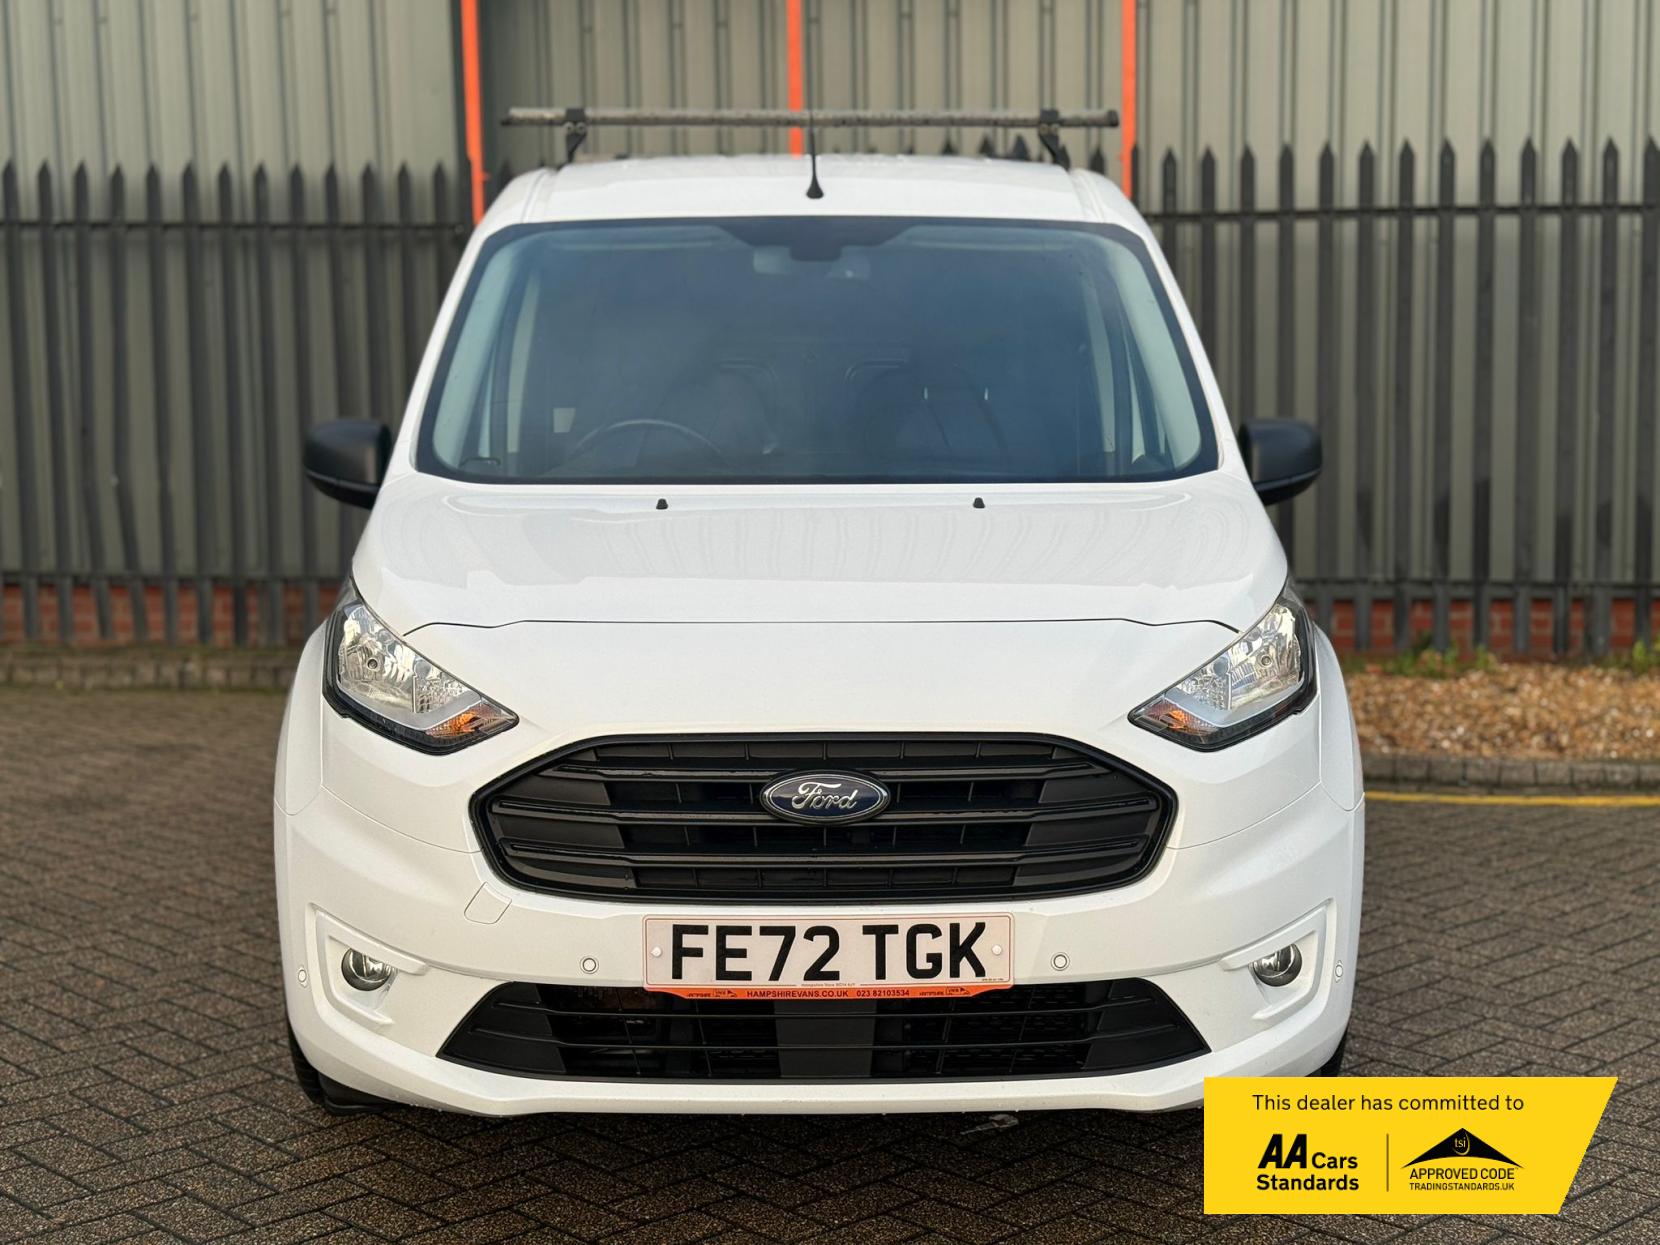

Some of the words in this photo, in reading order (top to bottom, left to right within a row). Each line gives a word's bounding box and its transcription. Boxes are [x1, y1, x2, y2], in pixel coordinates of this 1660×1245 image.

[791, 781, 858, 809] Ford
[671, 924, 840, 982] FE72
[862, 922, 986, 980] TGK
[746, 990, 849, 998] HAMPSHIREVANS.CO.UK
[856, 990, 870, 998] 023
[872, 989, 910, 998] 82103534
